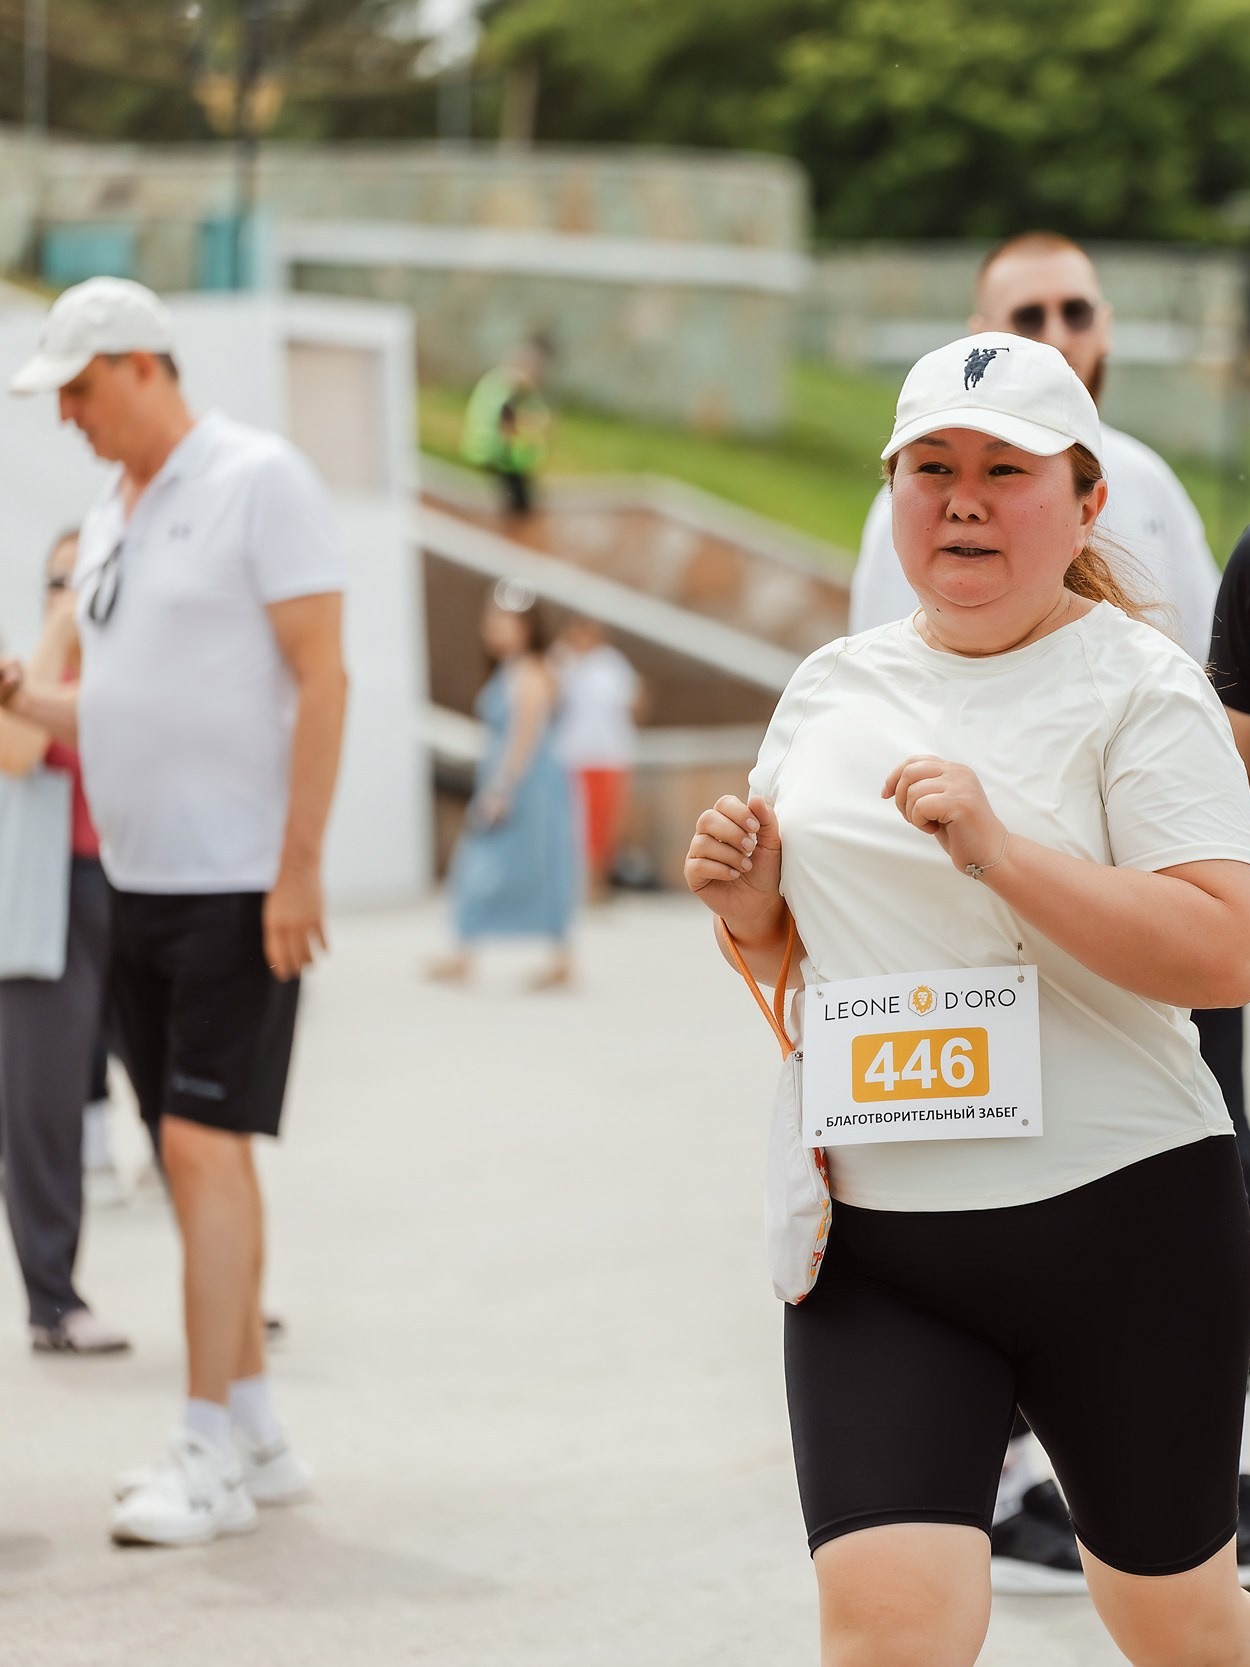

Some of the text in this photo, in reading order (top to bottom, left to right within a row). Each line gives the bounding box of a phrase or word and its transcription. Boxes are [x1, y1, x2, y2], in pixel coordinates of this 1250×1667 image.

[824, 988, 1016, 1021] LEONE D'ORO
[864, 1037, 975, 1091] 446
[826, 1106, 1018, 1127] БЛАГОТВОРИТЕЛЬНЫЙ ЗАБЕГ
